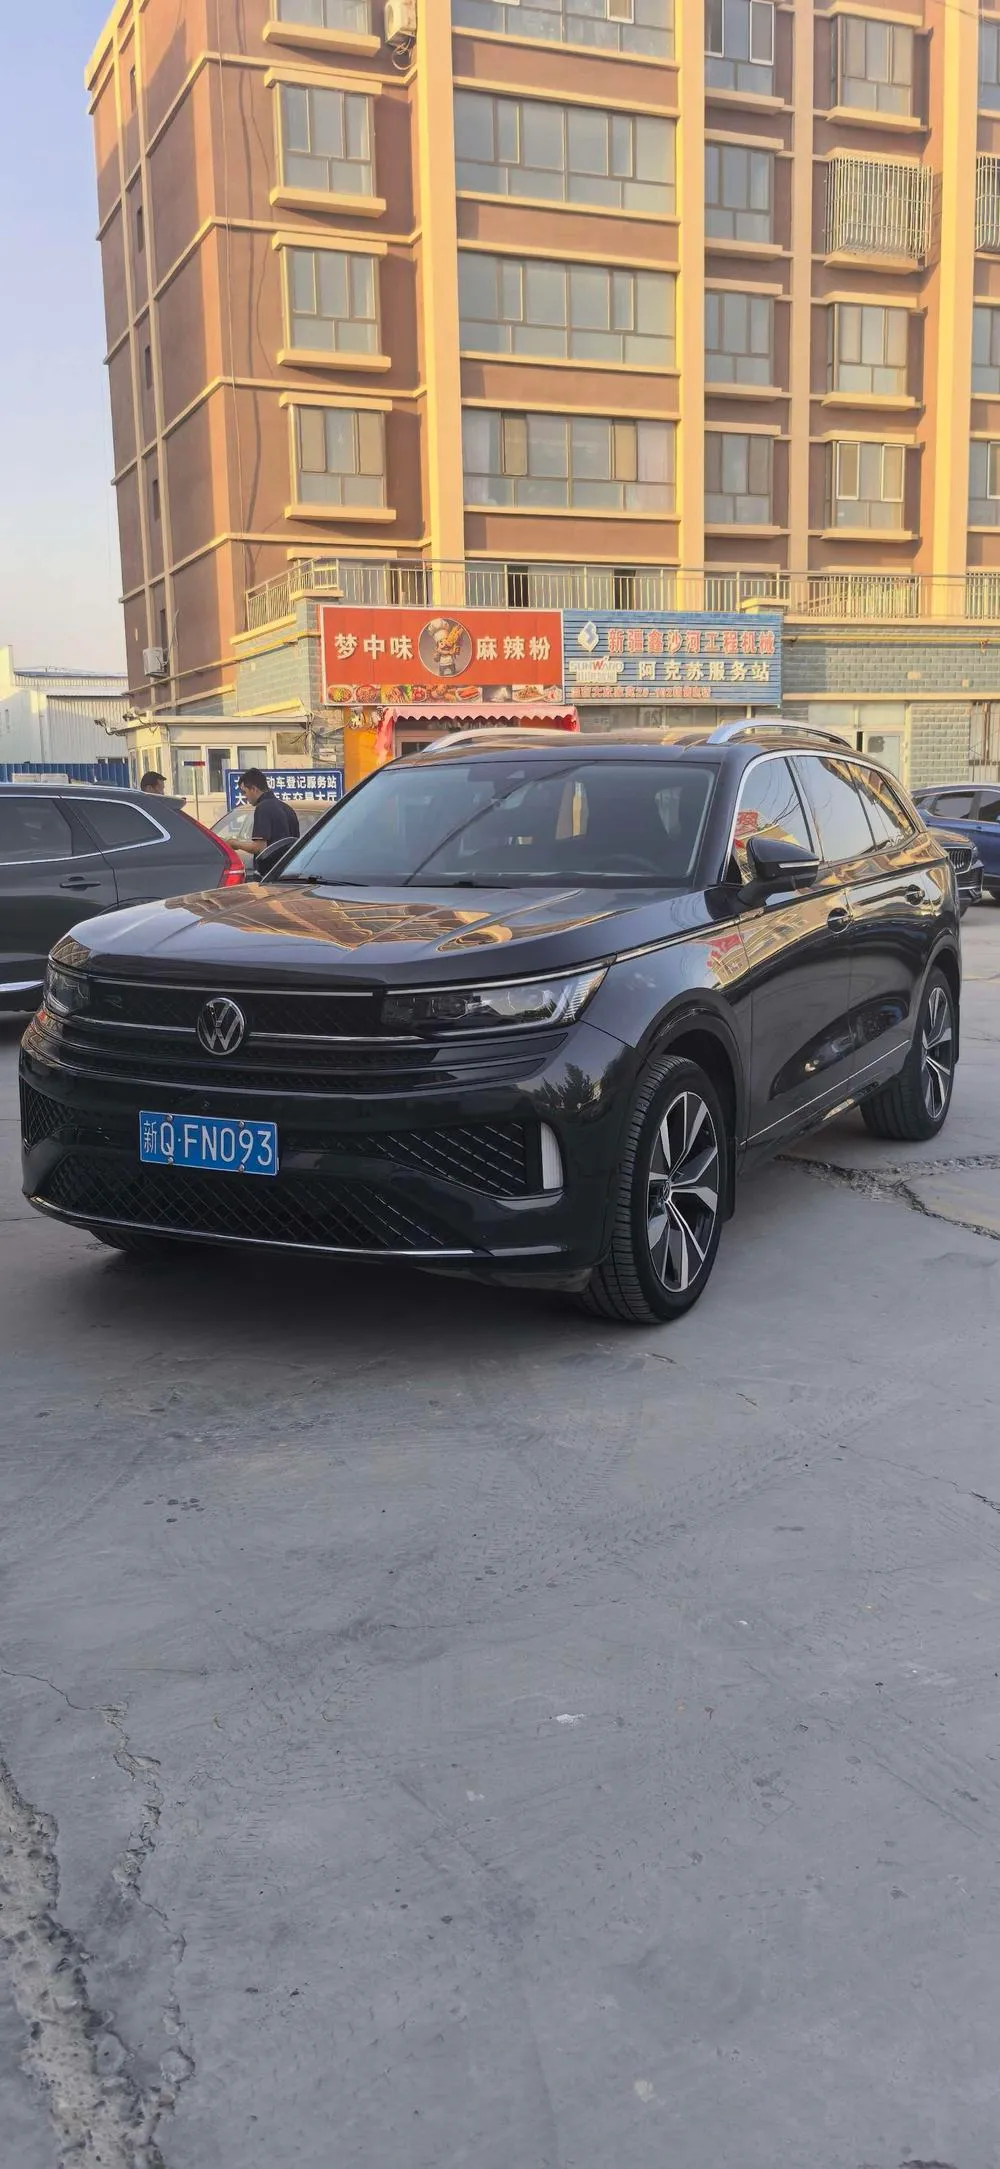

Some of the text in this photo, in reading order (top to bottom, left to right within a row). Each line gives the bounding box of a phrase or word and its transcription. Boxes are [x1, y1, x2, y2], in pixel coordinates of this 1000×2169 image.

[334, 633, 551, 661] 梦中味 麻辣粉
[607, 628, 775, 655] 新疆鑫沙河工程机械
[638, 659, 770, 681] 阿克苏服务站
